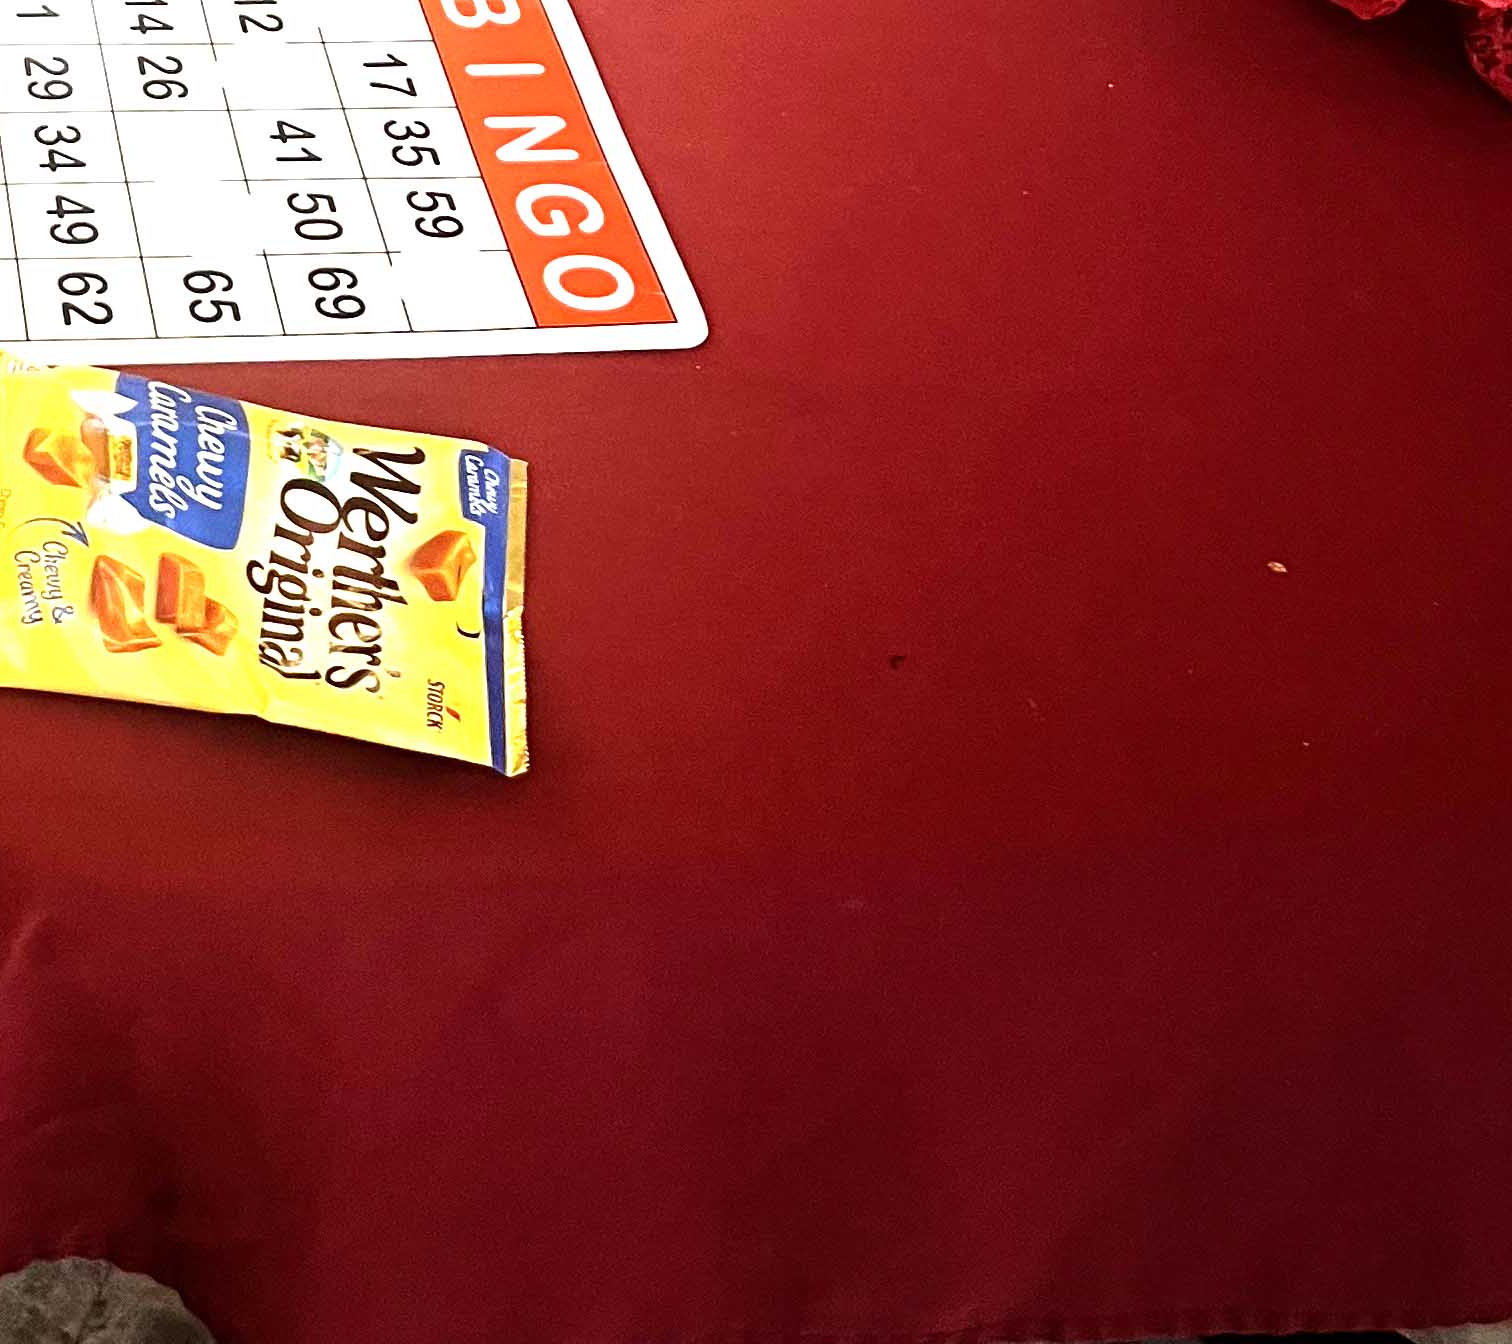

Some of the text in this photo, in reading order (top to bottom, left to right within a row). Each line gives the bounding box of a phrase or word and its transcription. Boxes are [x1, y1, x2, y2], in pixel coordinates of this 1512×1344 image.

[15, 4, 114, 326] 1 29 34 49 62
[268, 119, 323, 162] 41
[362, 52, 465, 239] 17 35 59
[136, 55, 189, 100] 26
[182, 269, 242, 324] 65
[286, 192, 344, 241] 50
[307, 267, 367, 320] 69
[146, 381, 192, 520] Caramels
[184, 402, 235, 513] Chewy
[462, 453, 485, 518] Caramels
[479, 468, 500, 514] Chewy
[14, 550, 43, 626] Creamy
[42, 539, 72, 602] Chewy
[246, 482, 323, 680] Original
[331, 445, 427, 694] Werther's
[426, 680, 442, 729] STORCK
